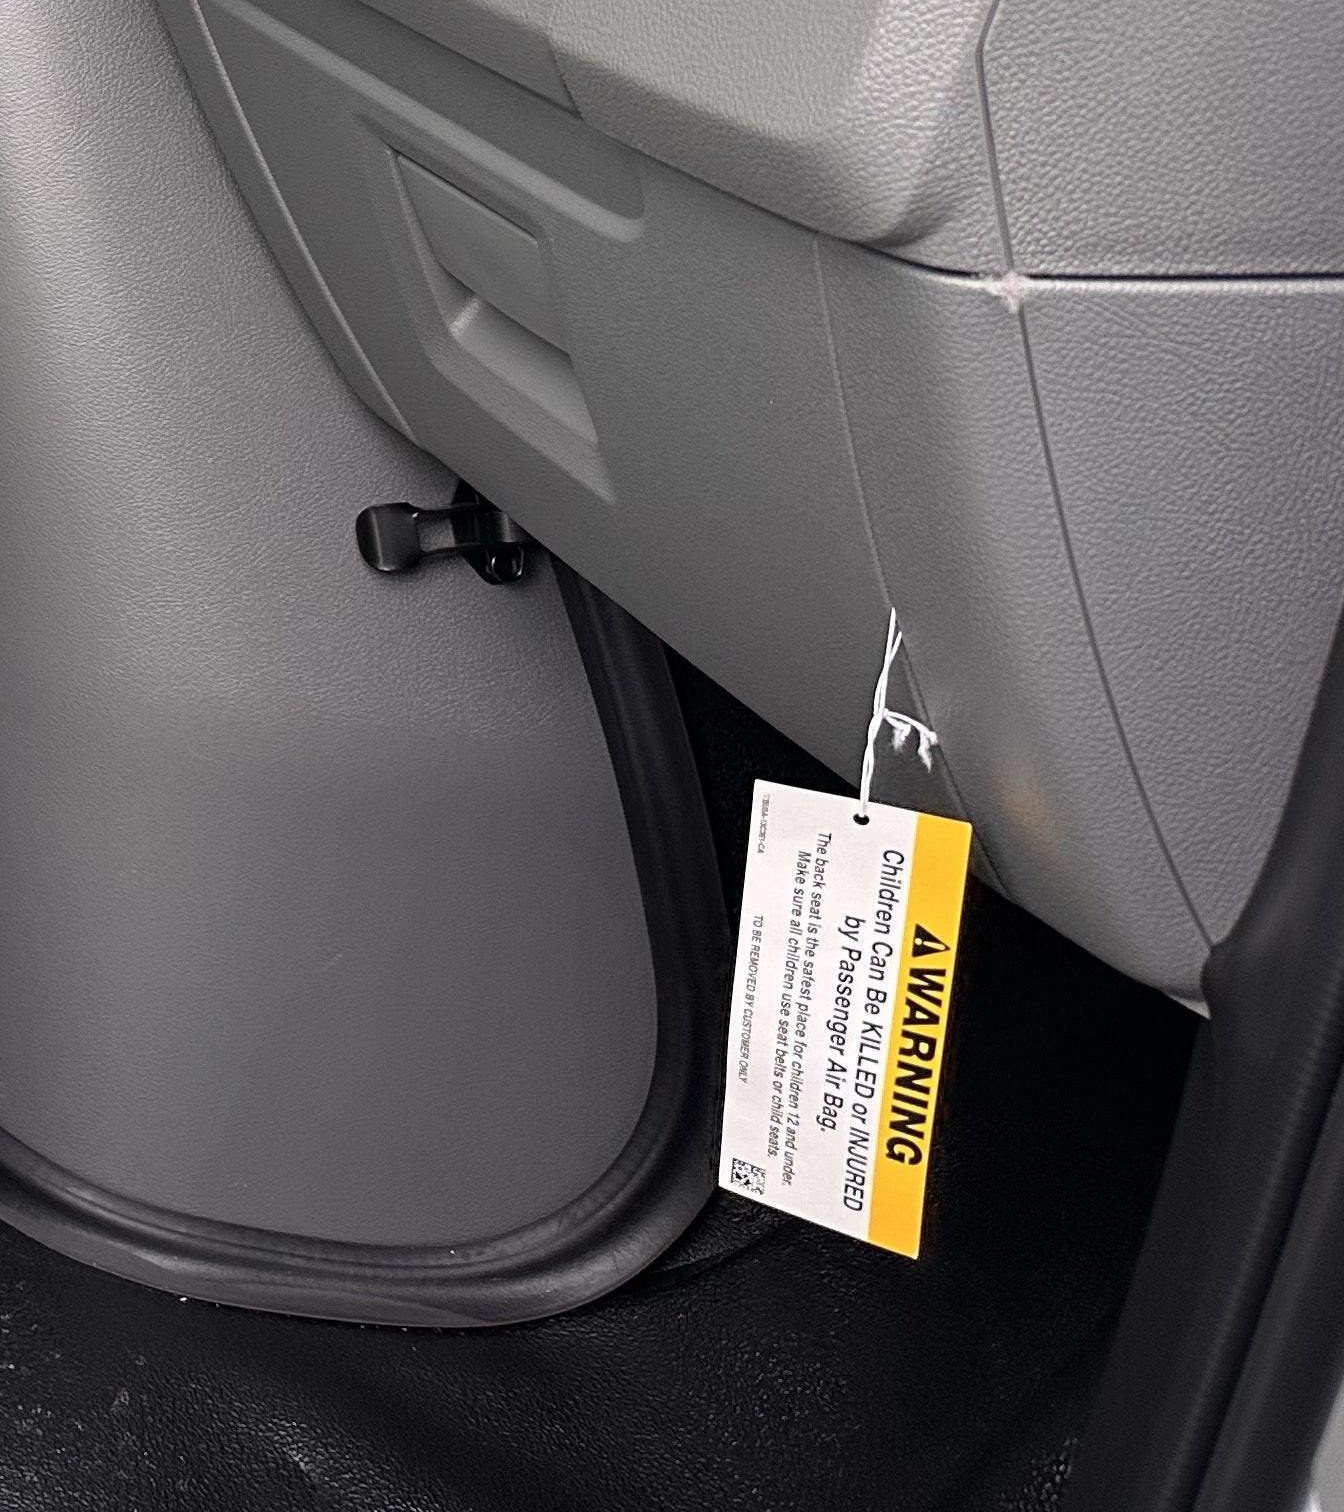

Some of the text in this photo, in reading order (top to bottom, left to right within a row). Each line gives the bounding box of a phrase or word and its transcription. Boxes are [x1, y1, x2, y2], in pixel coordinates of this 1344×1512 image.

[738, 915, 764, 1084] TO BE REMOVED BY CUSTOMER ONLY
[767, 850, 812, 1158] Make sure all children use seat belts or child seats.
[782, 832, 832, 1187] The back seat is the safest place for children 12 and under.
[816, 915, 866, 1132] by Passenger Air Bag.
[842, 849, 905, 1212] Children Can Be KILLED or INJURED
[885, 967, 947, 1166] WARNING
